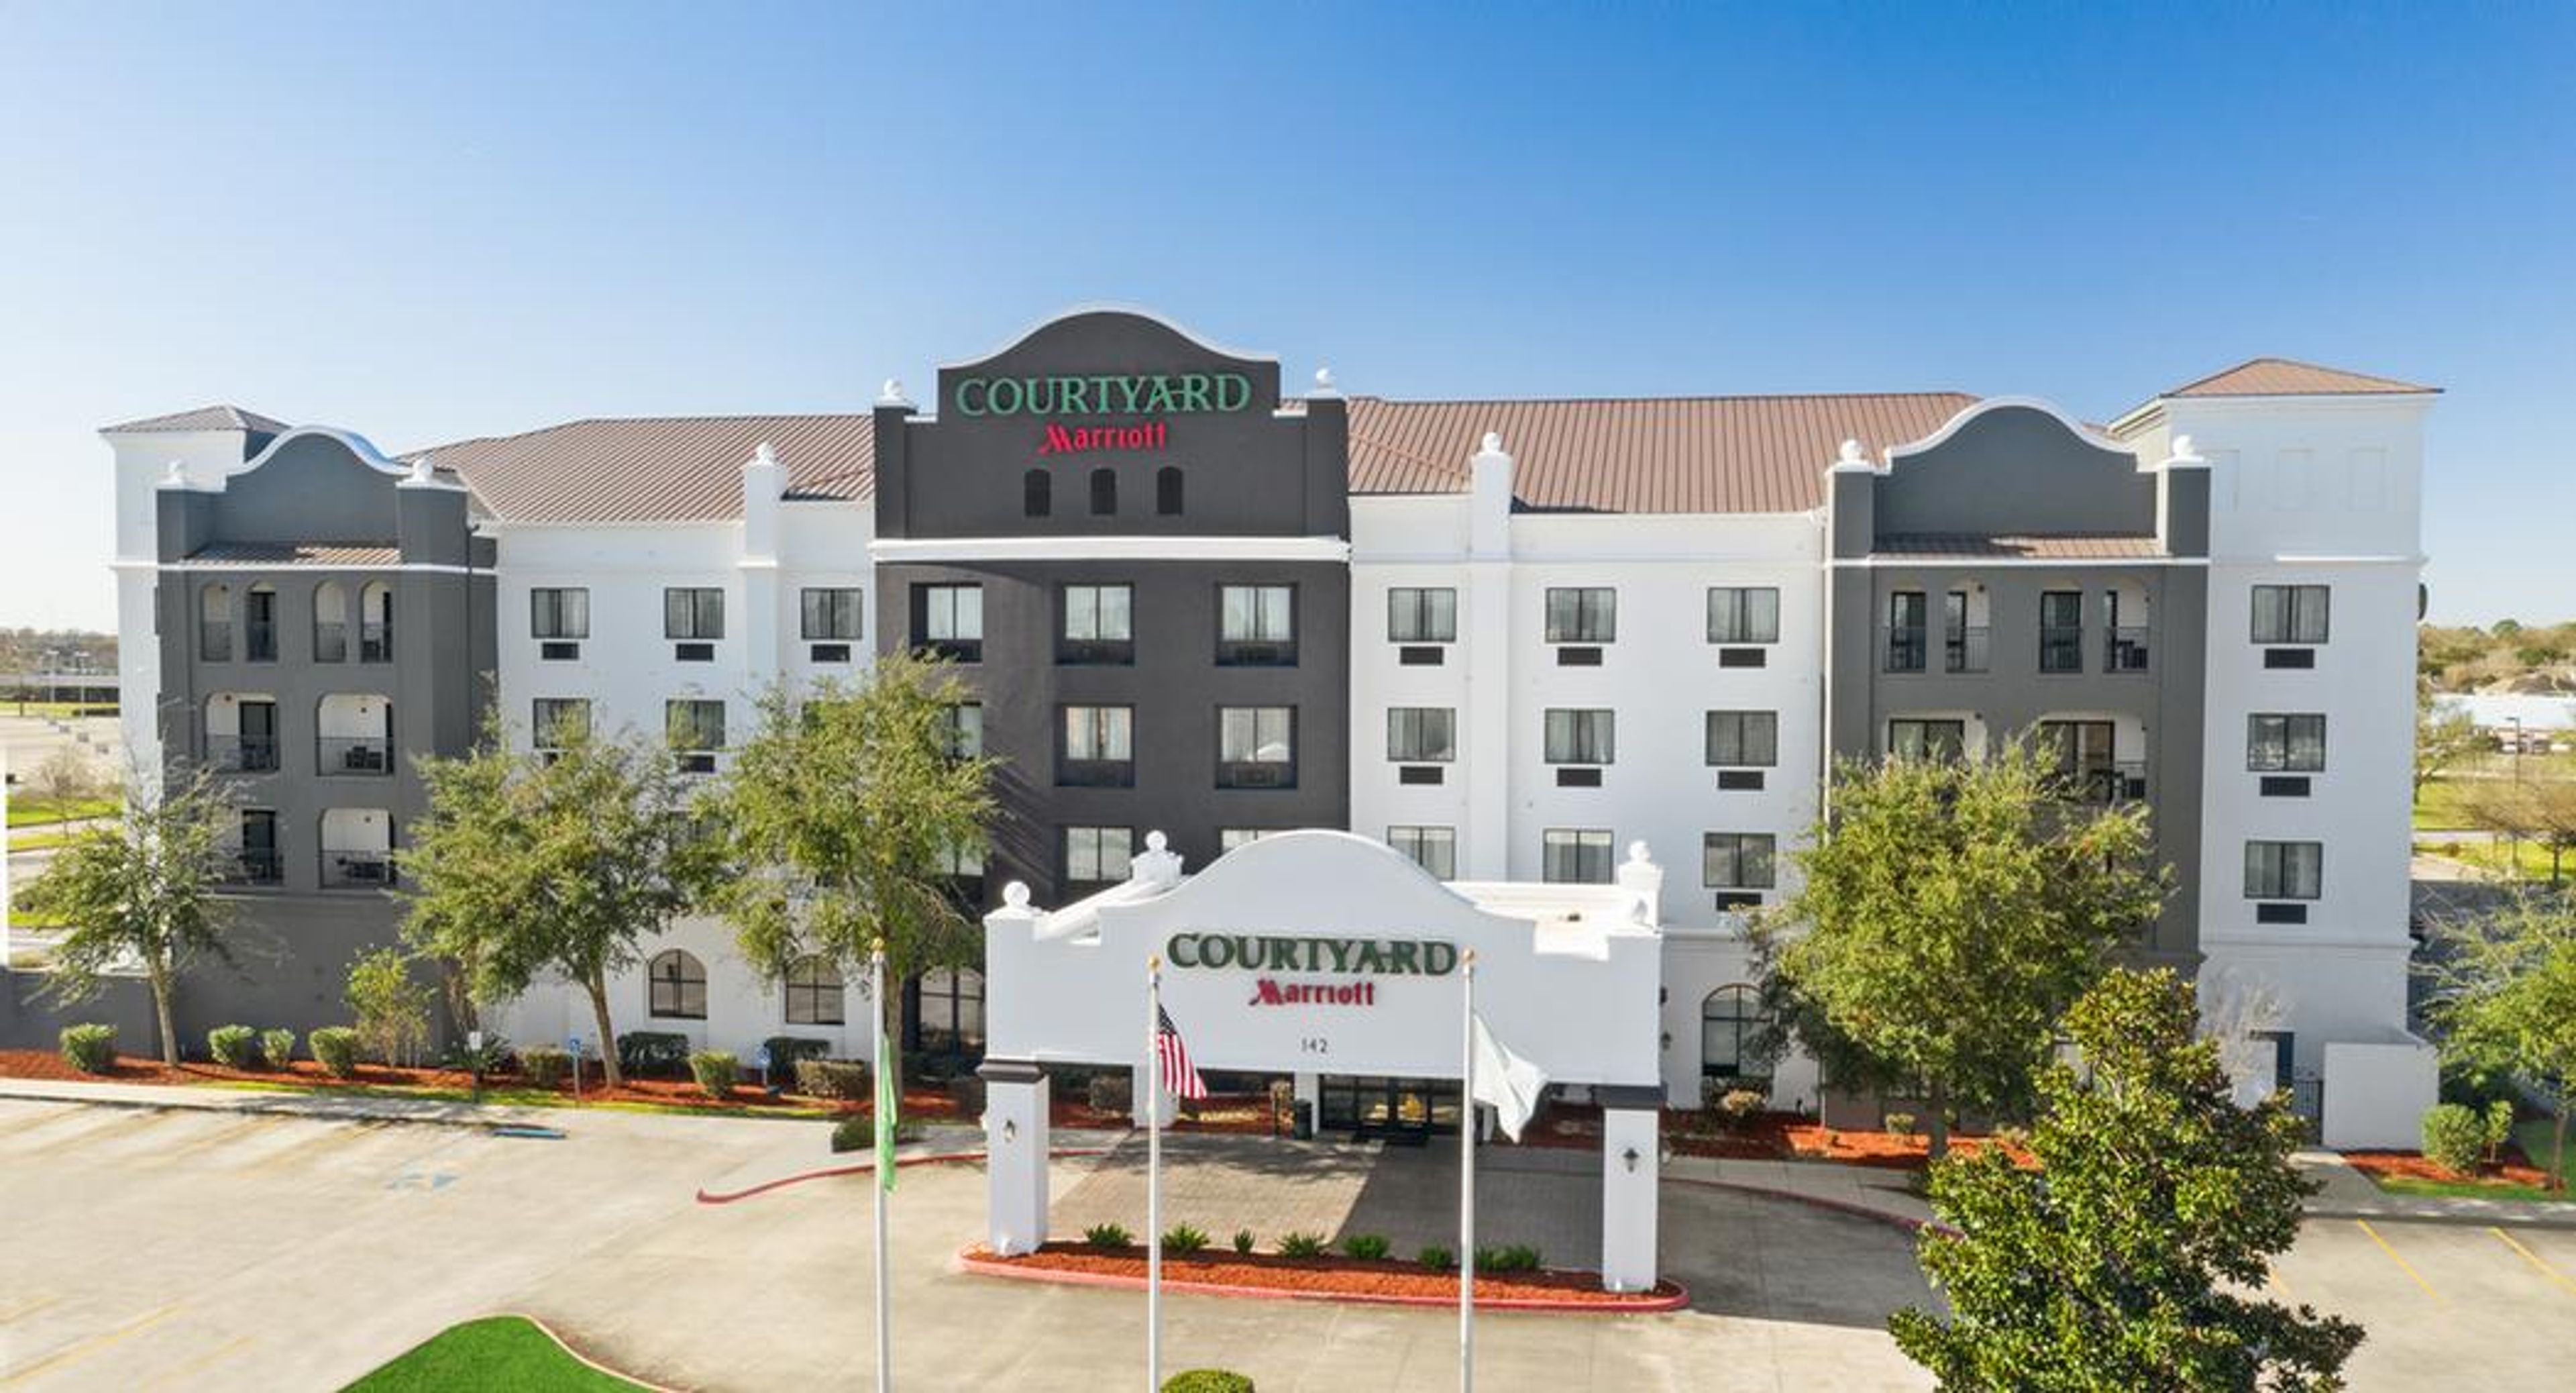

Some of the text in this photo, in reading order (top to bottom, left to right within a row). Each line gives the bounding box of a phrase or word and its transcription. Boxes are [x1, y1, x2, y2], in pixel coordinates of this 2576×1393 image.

[956, 374, 1251, 416] COURTYARD
[1039, 421, 1166, 454] Marriott
[1167, 933, 1458, 976] COURTYARD
[1249, 979, 1375, 1006] Marriott
[1301, 1038, 1328, 1053] 142
